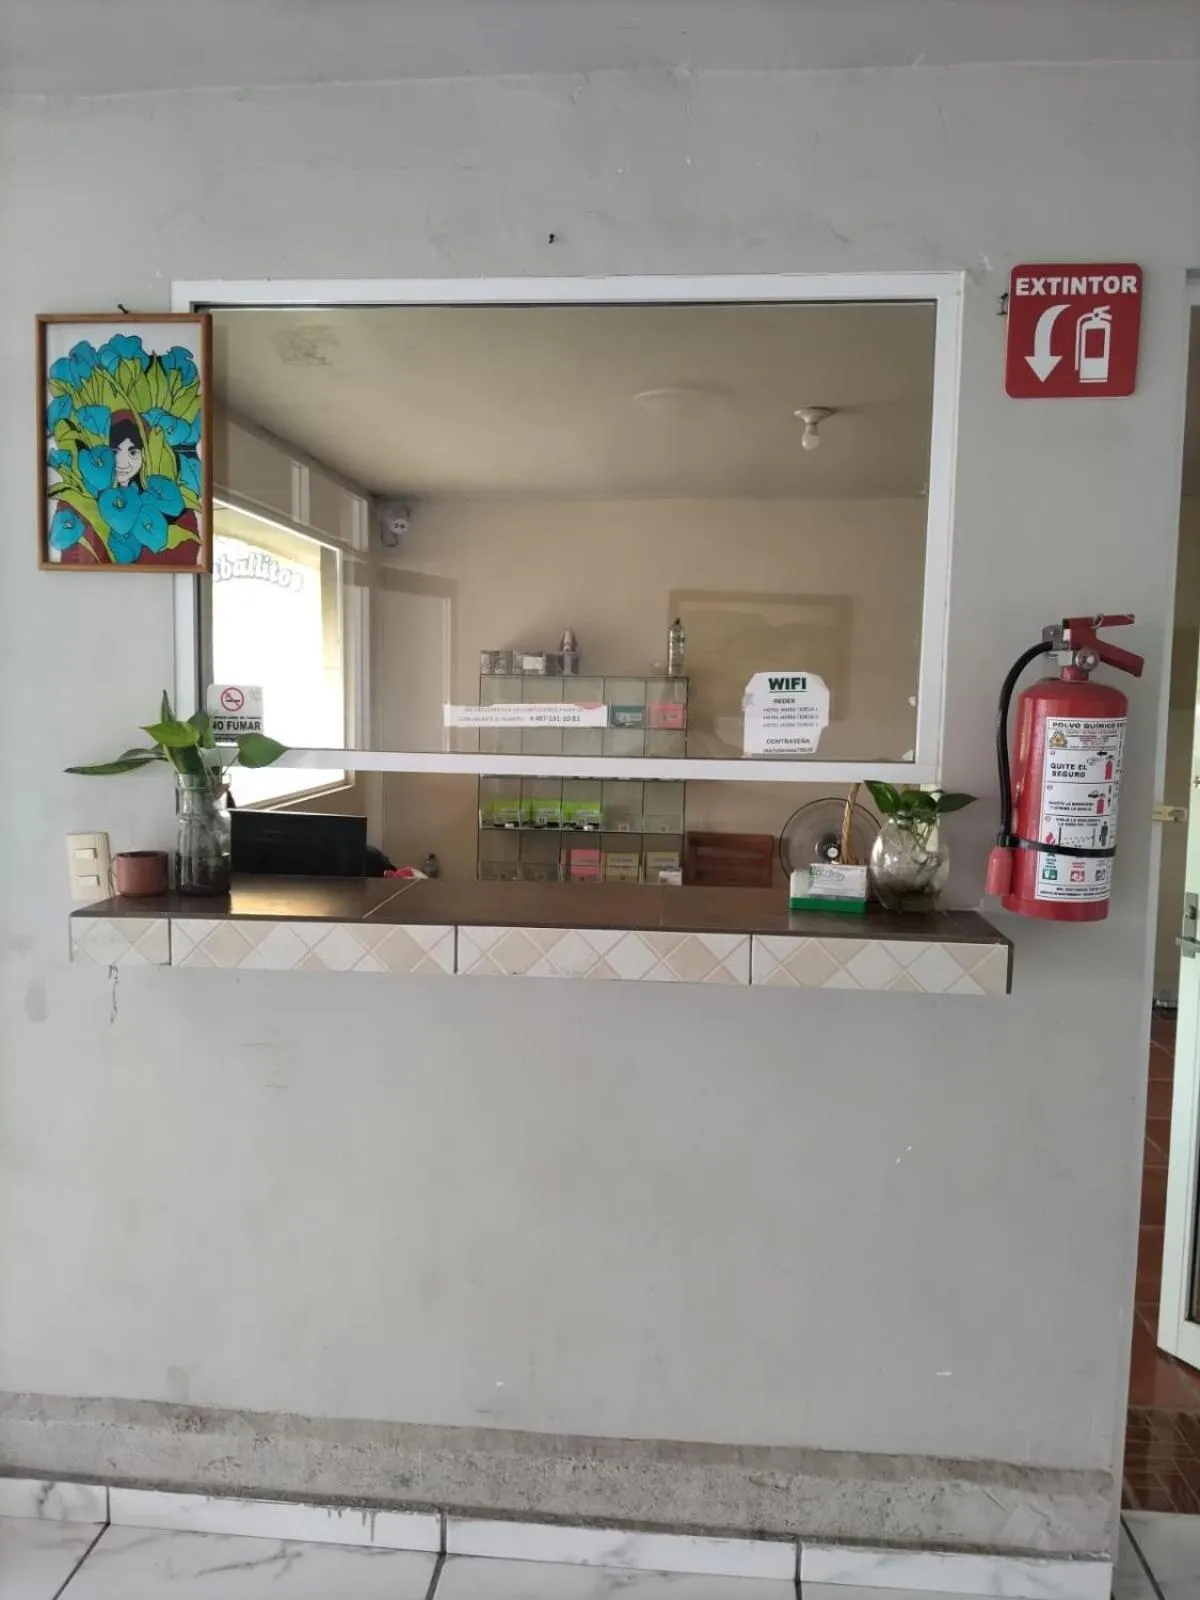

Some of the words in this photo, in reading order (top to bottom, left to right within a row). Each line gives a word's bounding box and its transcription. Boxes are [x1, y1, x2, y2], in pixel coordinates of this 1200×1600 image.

[1015, 275, 1138, 296] EXTINTOR
[768, 677, 807, 690] WIFI
[226, 720, 261, 731] FUMAR
